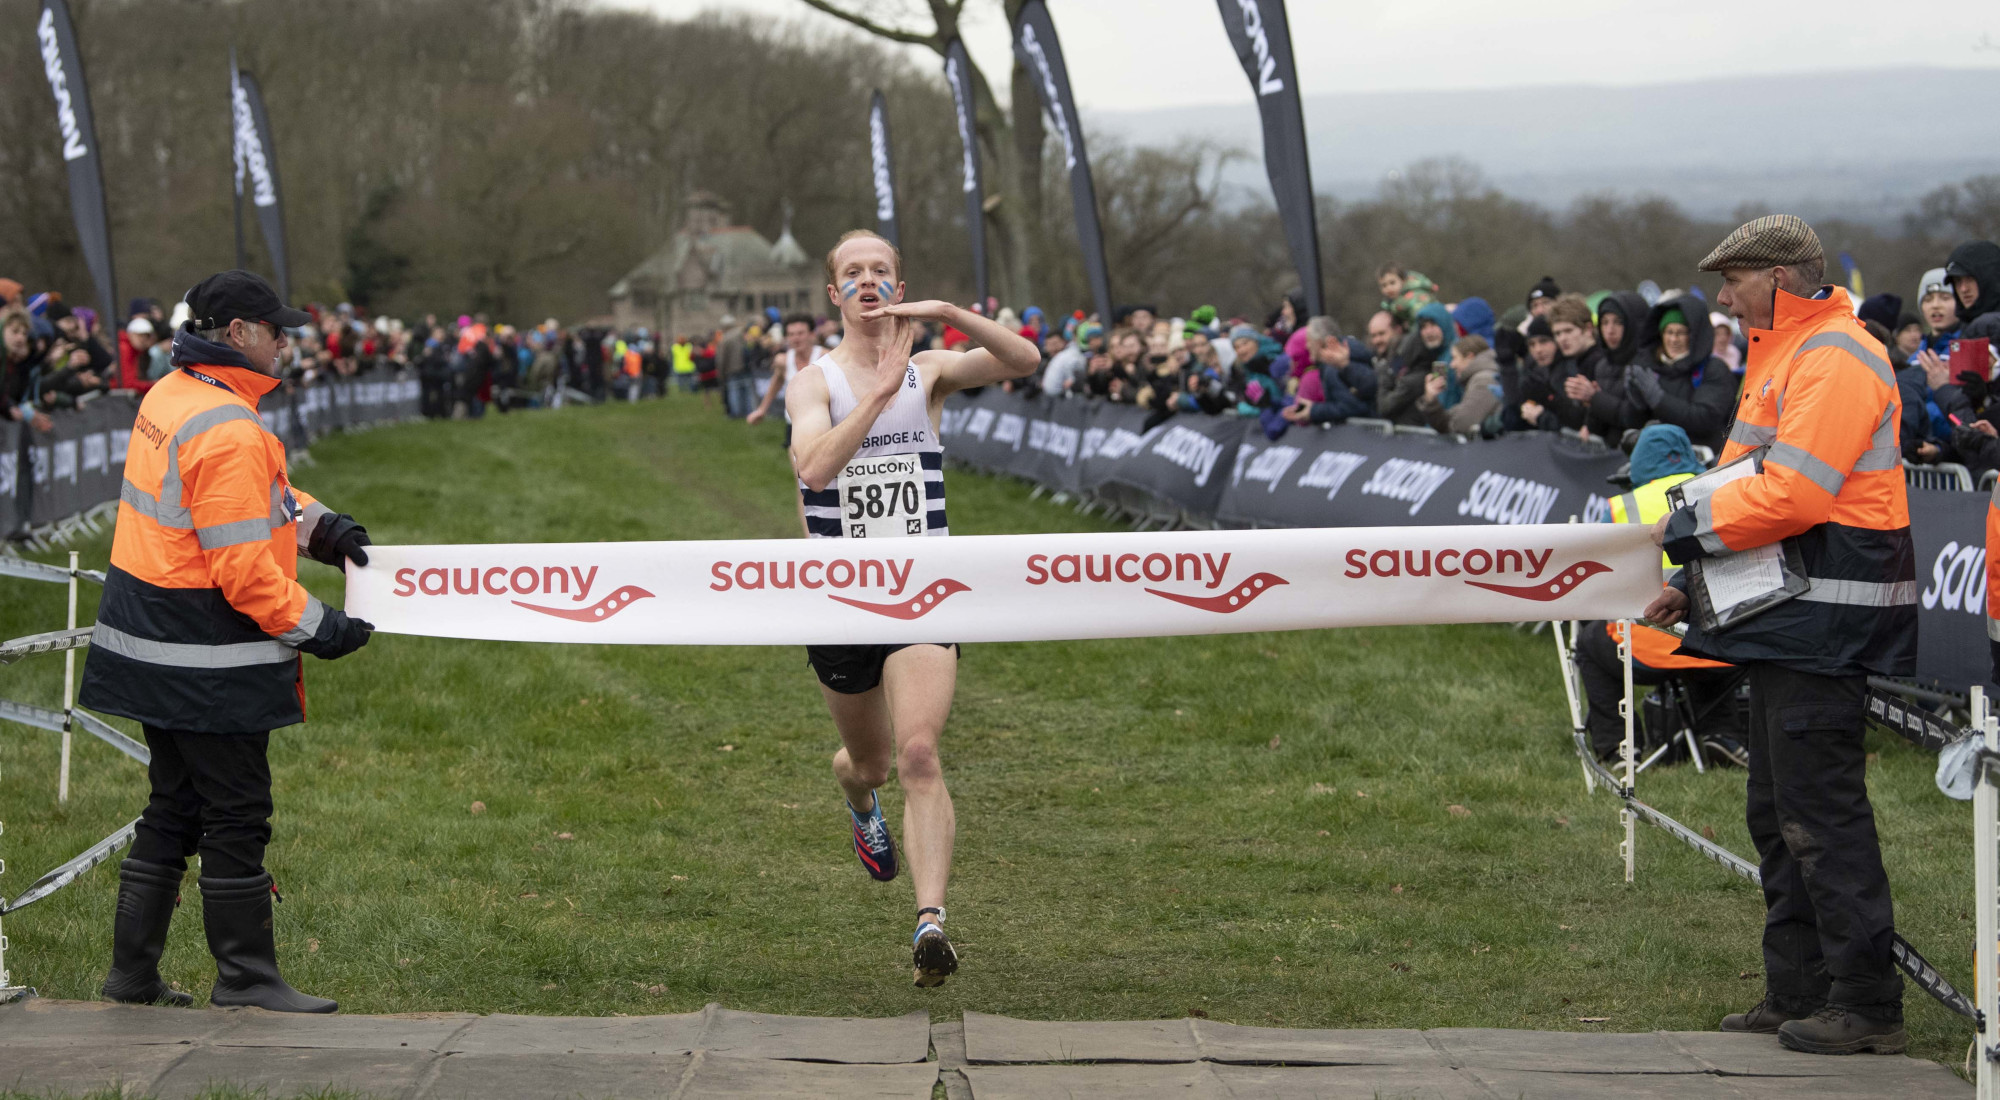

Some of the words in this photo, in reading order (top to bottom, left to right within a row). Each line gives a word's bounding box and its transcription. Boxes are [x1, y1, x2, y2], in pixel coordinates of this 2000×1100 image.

[136, 412, 168, 450] aucony
[861, 431, 909, 449] BRIDGE
[911, 430, 925, 443] AC
[846, 461, 915, 478] saucony
[848, 480, 919, 520] 5870
[393, 566, 598, 602] saucony
[711, 559, 914, 596] saucony
[1026, 553, 1231, 589] saucony
[1345, 548, 1552, 579] saucony
